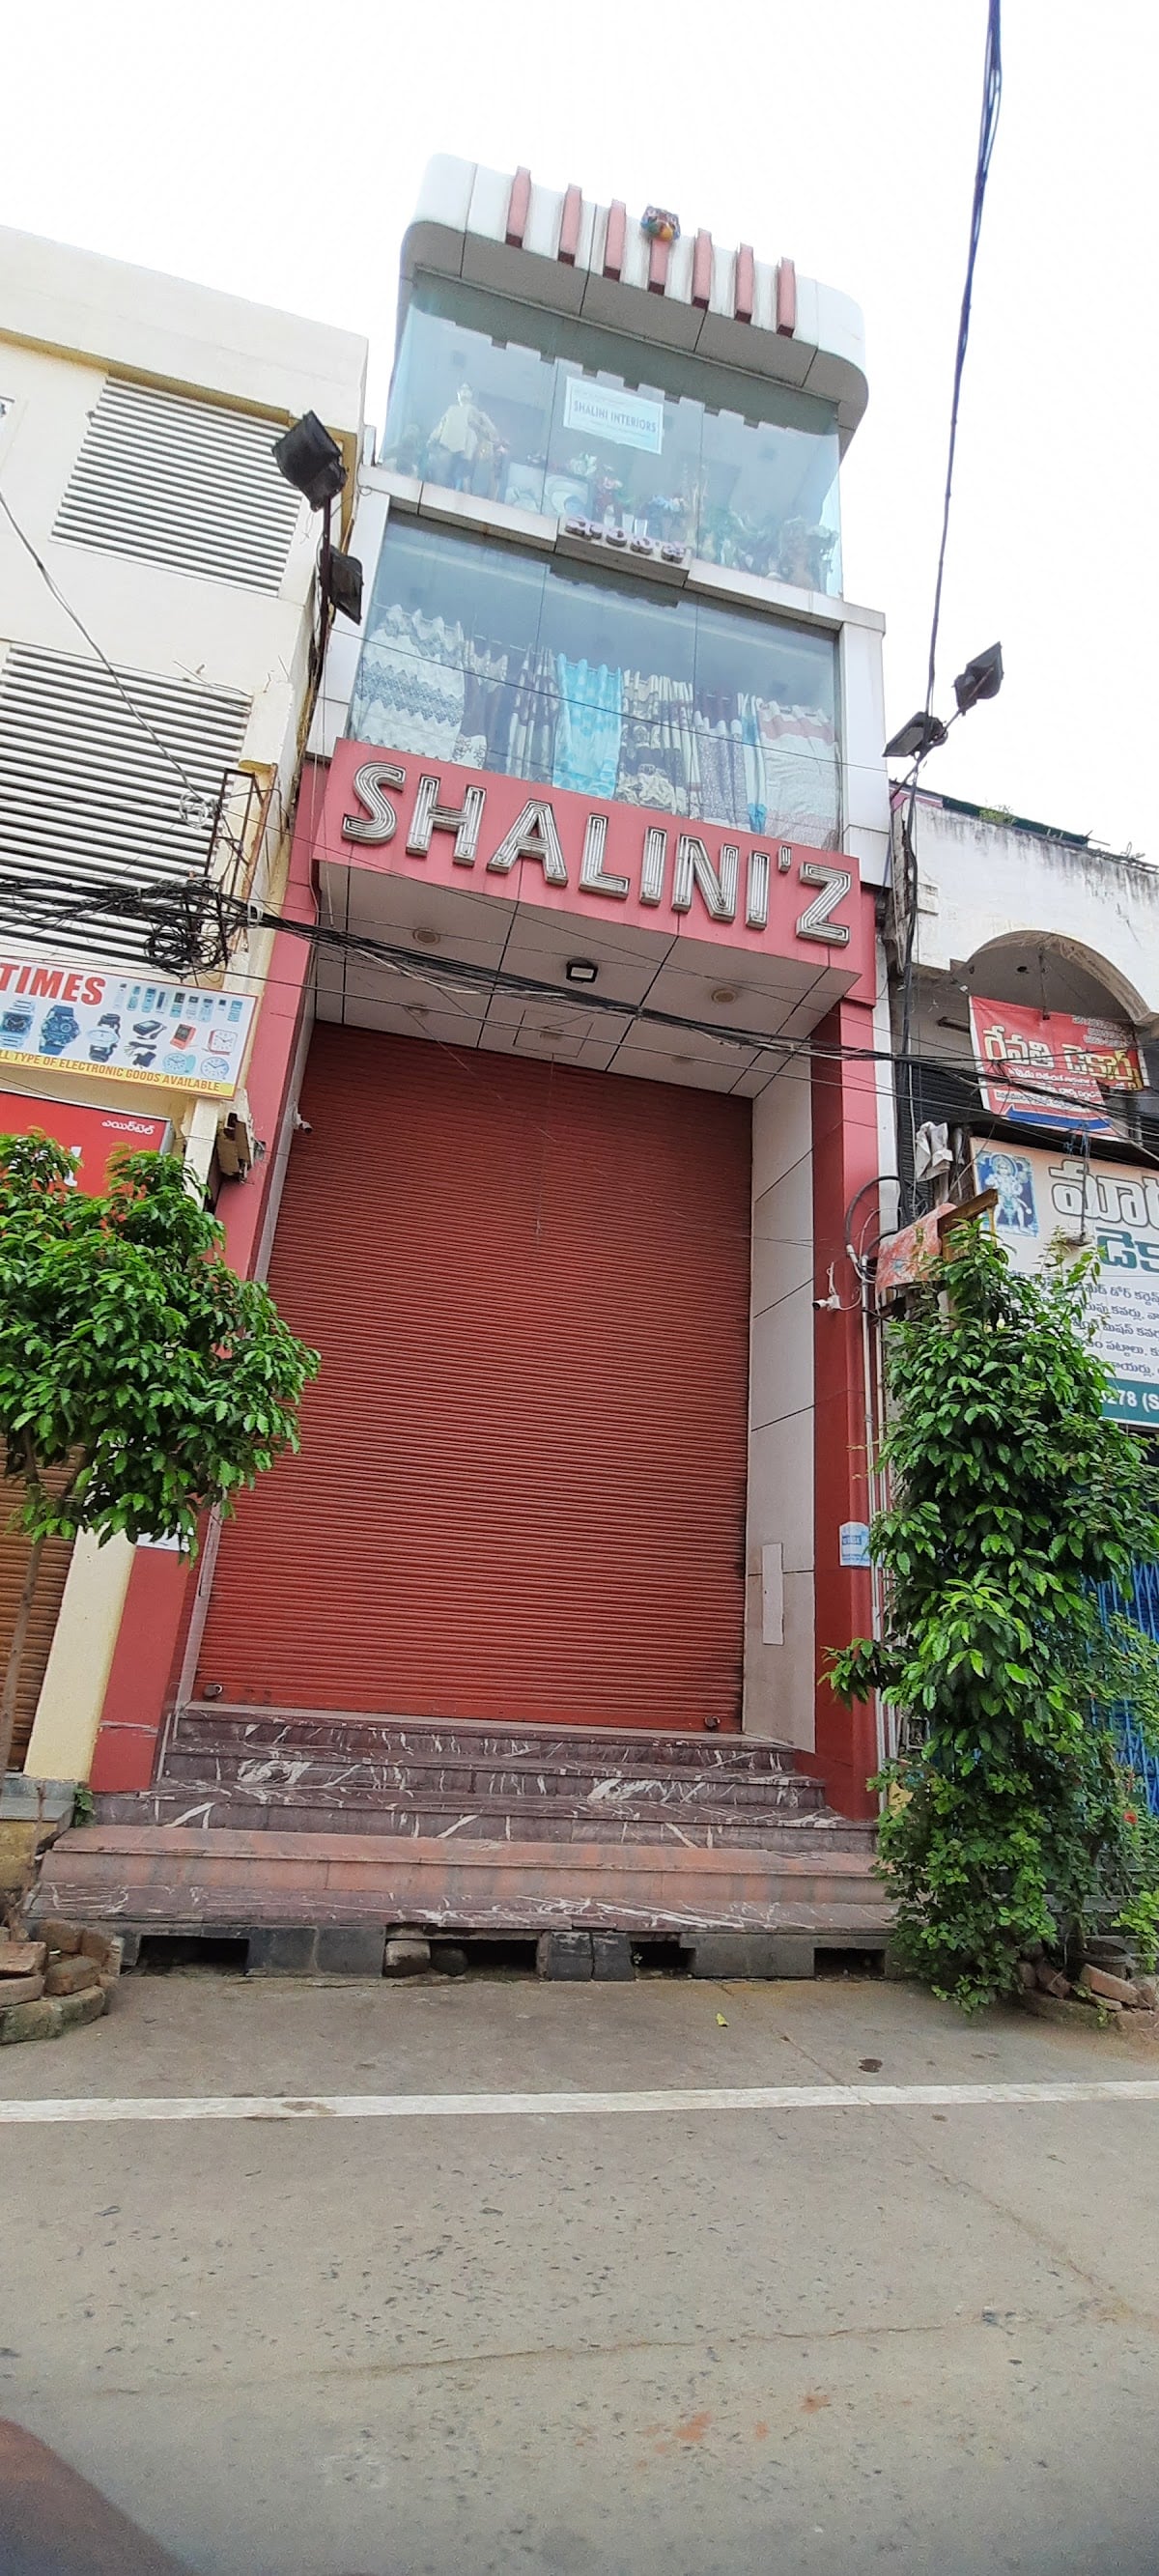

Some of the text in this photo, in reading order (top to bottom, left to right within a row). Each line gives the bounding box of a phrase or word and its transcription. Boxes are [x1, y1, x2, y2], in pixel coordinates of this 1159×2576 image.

[610, 411, 657, 434] INTERIORS
[342, 763, 851, 947] SHALINI'Z
[0, 963, 106, 1005] TIMES
[14, 1051, 40, 1063] TYPE
[43, 1056, 57, 1066] OF
[59, 1059, 124, 1077] ELECTRONIC
[126, 1069, 161, 1083] GOODS
[162, 1075, 221, 1091] AVAILABLE
